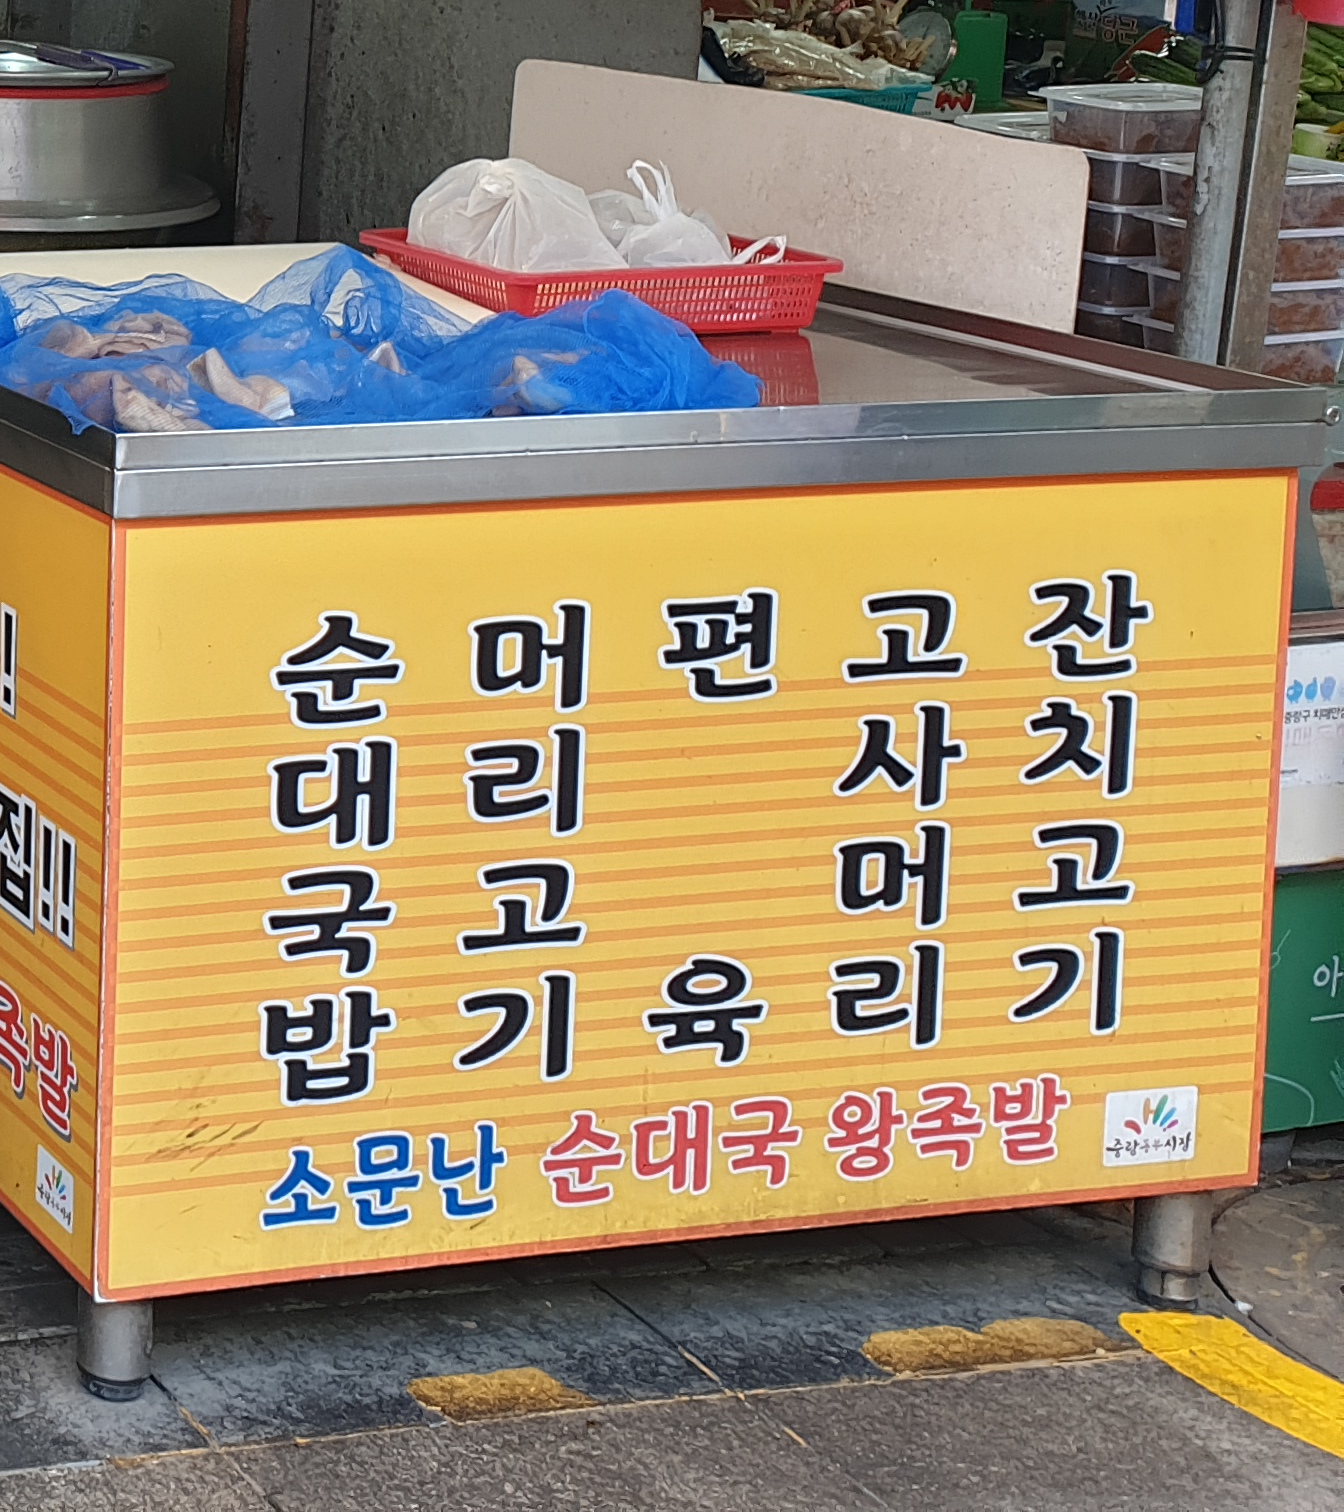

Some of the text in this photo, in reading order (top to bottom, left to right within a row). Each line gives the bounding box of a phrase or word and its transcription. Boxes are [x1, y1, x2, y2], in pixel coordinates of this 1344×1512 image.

[259, 1071, 1070, 1231] 소문난 순대국 왕족발
